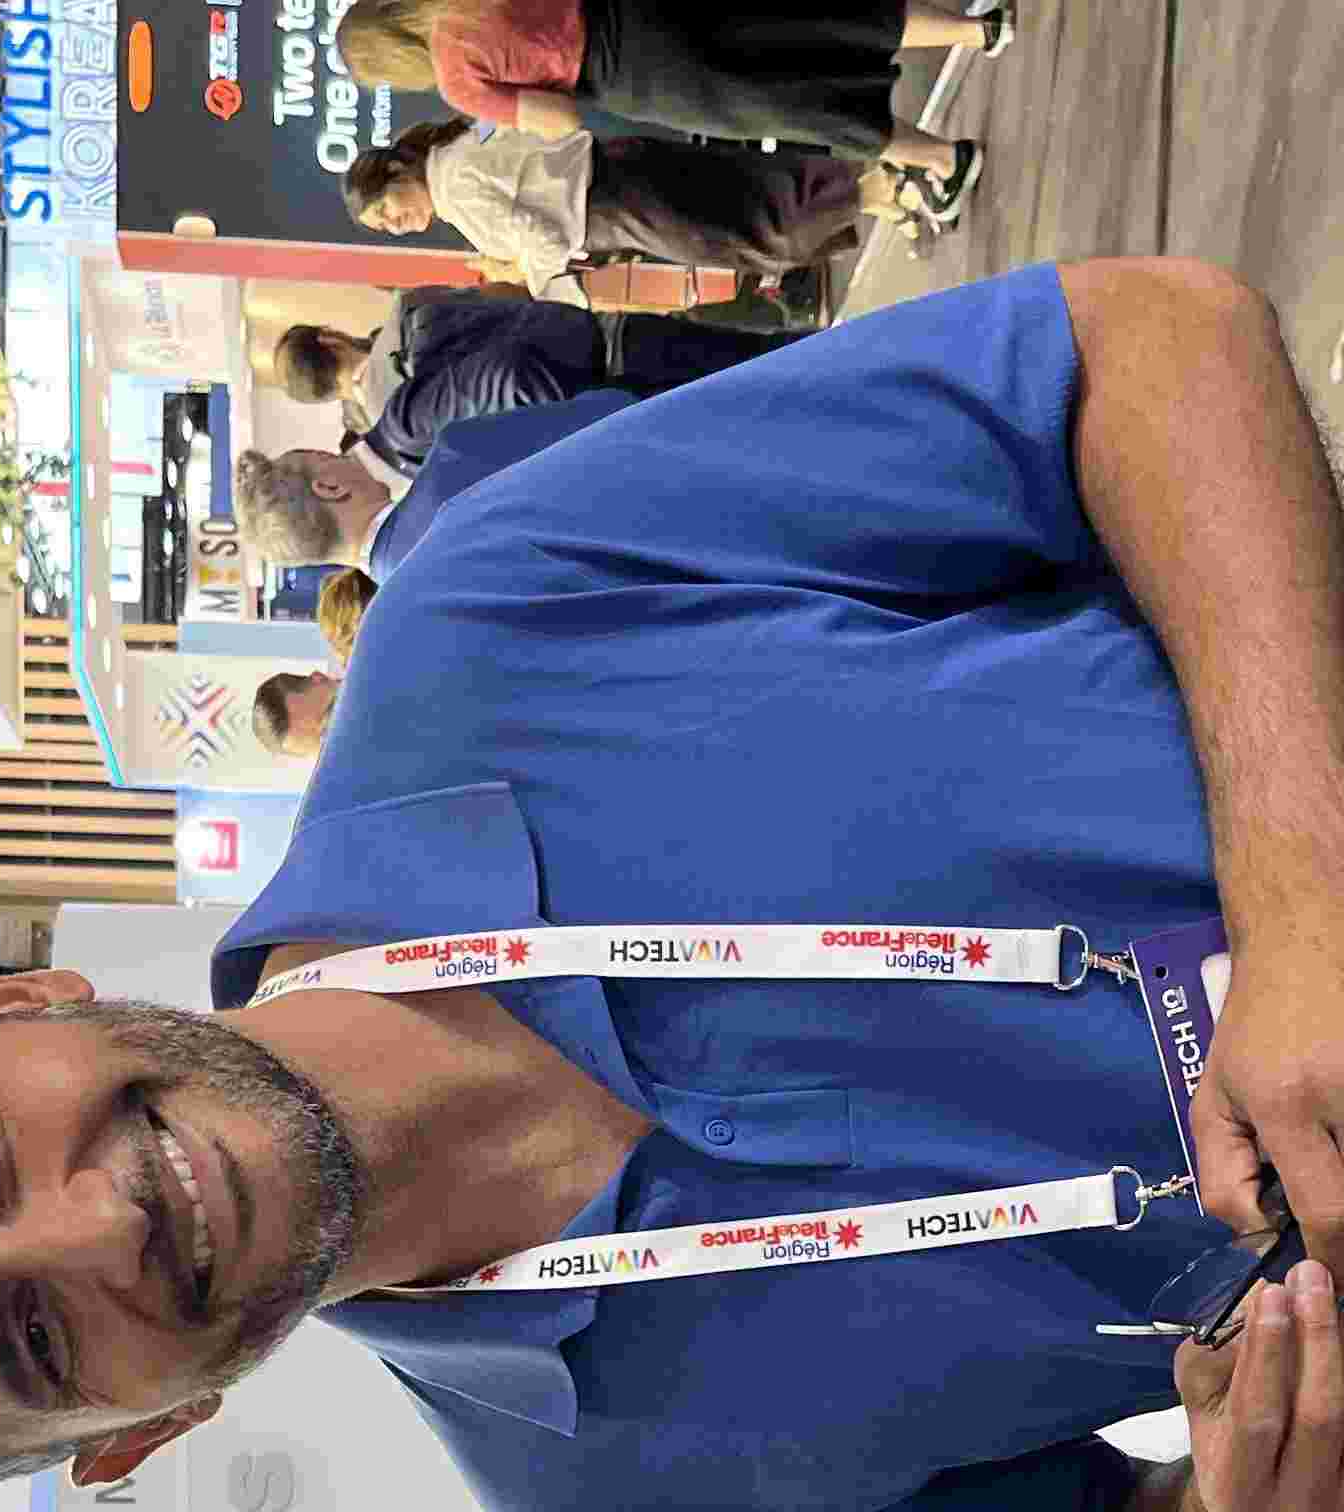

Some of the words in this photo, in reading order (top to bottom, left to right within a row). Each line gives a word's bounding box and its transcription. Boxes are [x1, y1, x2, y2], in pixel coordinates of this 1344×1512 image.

[272, 36, 315, 126] Two
[1, 0, 52, 223] STYLISH
[315, 79, 359, 173] One
[608, 938, 743, 963] VIVATECH
[884, 951, 955, 974] Région
[431, 957, 498, 977] Région
[906, 1202, 1039, 1239] VIVATECH
[761, 1241, 831, 1260] Région
